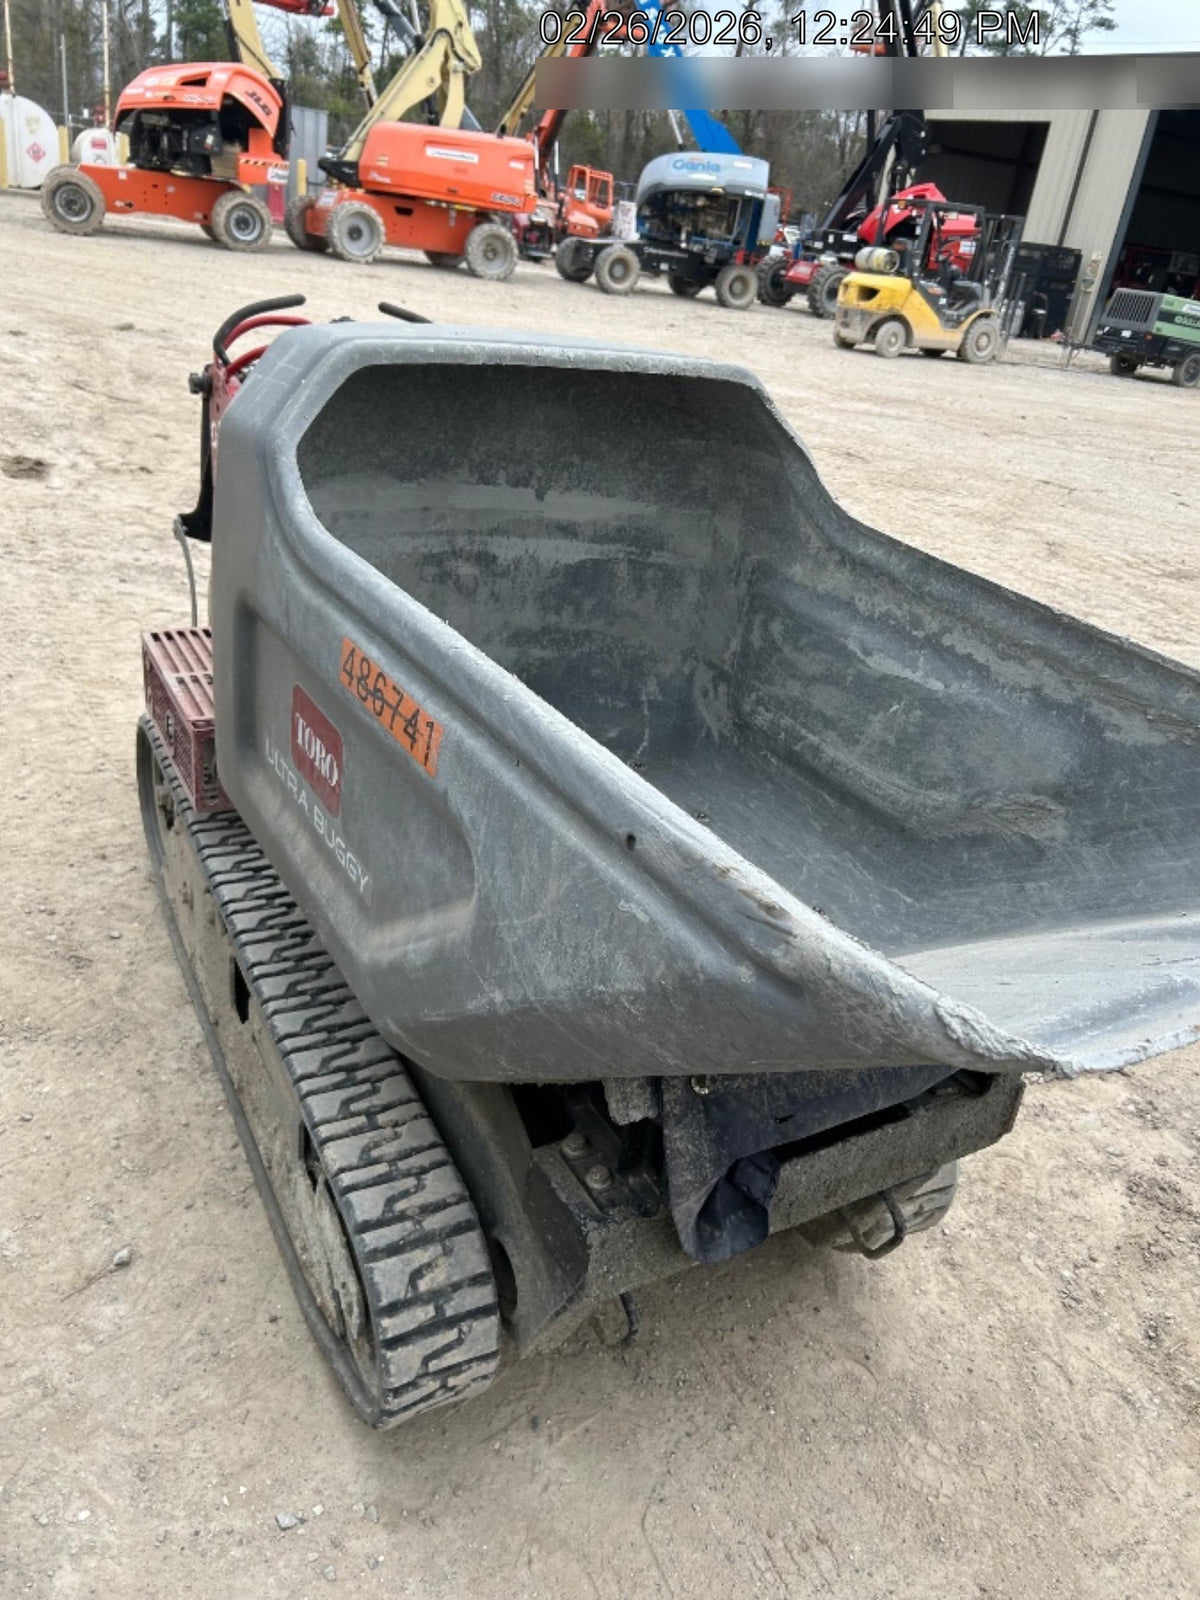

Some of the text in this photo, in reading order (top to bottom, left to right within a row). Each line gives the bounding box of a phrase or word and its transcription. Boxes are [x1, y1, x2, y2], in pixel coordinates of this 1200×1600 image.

[245, 90, 273, 117] JLG
[672, 159, 721, 172] Genie
[342, 646, 435, 768] 486741
[295, 711, 339, 787] TORO
[265, 737, 369, 894] ULTRA BUGGY
